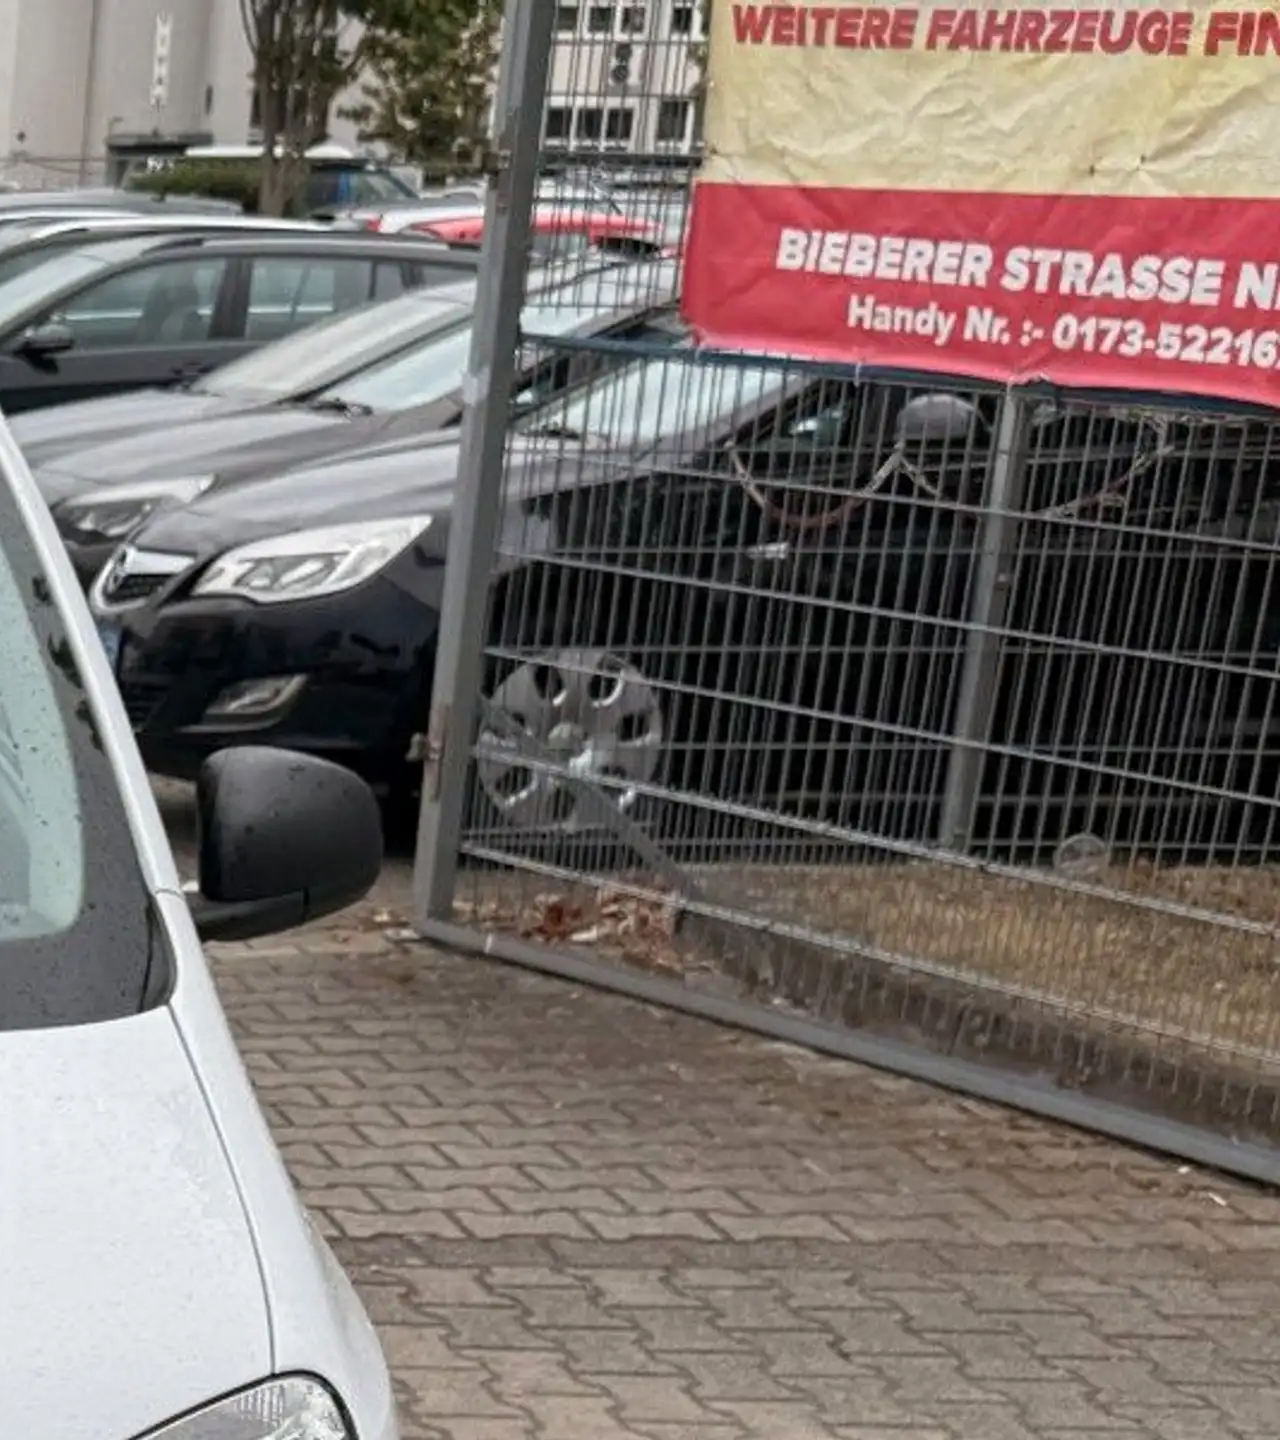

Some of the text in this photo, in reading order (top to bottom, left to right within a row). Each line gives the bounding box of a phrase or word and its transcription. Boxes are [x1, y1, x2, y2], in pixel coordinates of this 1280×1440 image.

[733, 4, 1280, 56] WEITERE FAHRZEUGE FIN
[776, 228, 1280, 311] BIEBERER STRASSE N
[847, 294, 957, 347] Handy
[963, 305, 1011, 345] Nr.
[1052, 313, 1280, 369] 0173-52216
